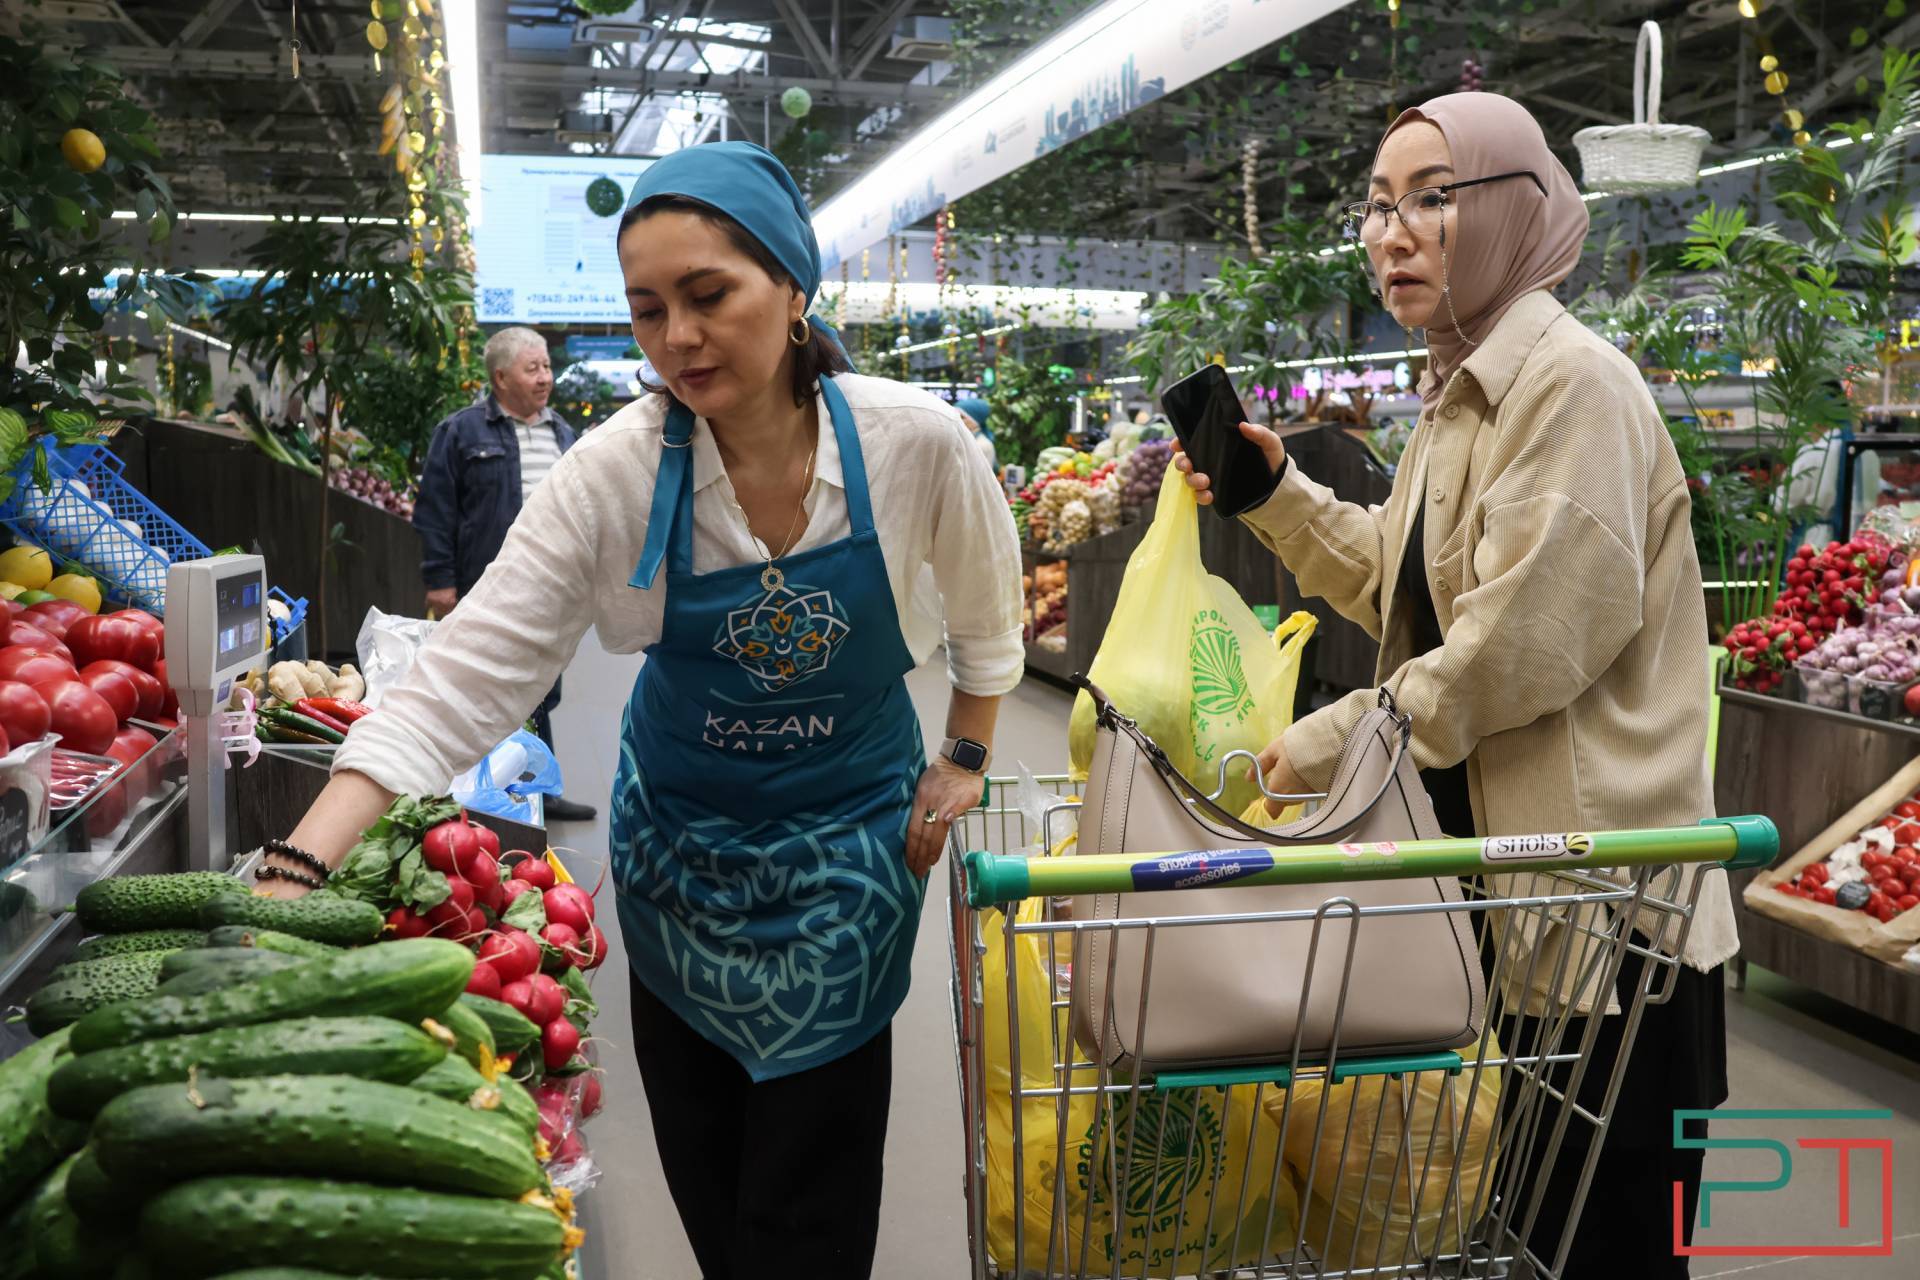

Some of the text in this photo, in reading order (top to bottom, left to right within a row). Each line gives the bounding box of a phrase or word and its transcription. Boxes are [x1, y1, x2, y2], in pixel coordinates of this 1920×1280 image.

[705, 709, 834, 738] KAZAN
[1159, 851, 1209, 873] shopping
[1175, 862, 1241, 888] accessories
